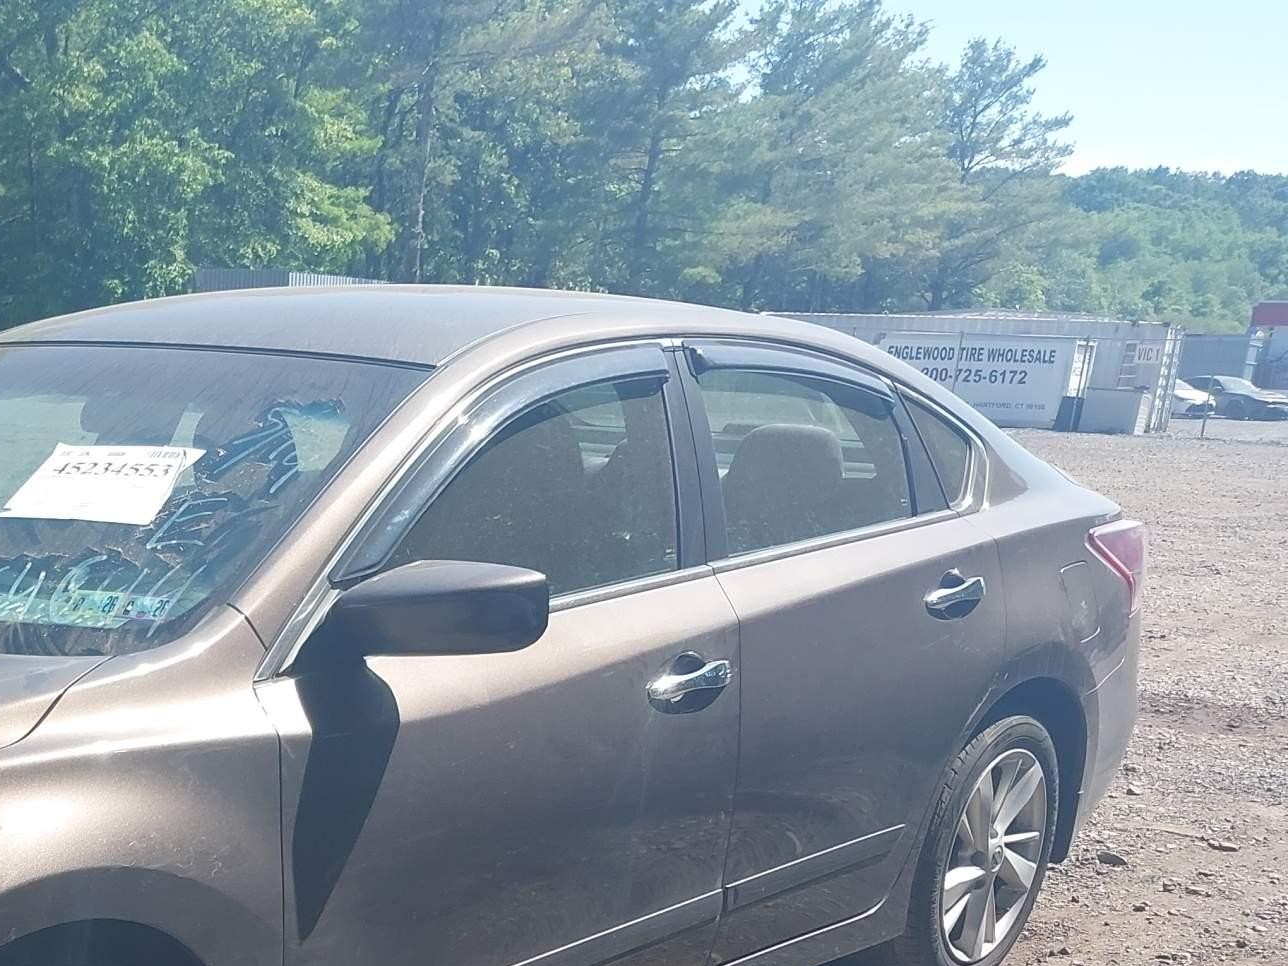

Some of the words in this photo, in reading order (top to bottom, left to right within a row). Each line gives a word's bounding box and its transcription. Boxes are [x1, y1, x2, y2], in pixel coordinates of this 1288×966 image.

[887, 345, 955, 361] ENGLEWOOD
[957, 347, 985, 362] TIRE
[986, 348, 1057, 364] WHOLESALE
[53, 462, 173, 477] 45234553
